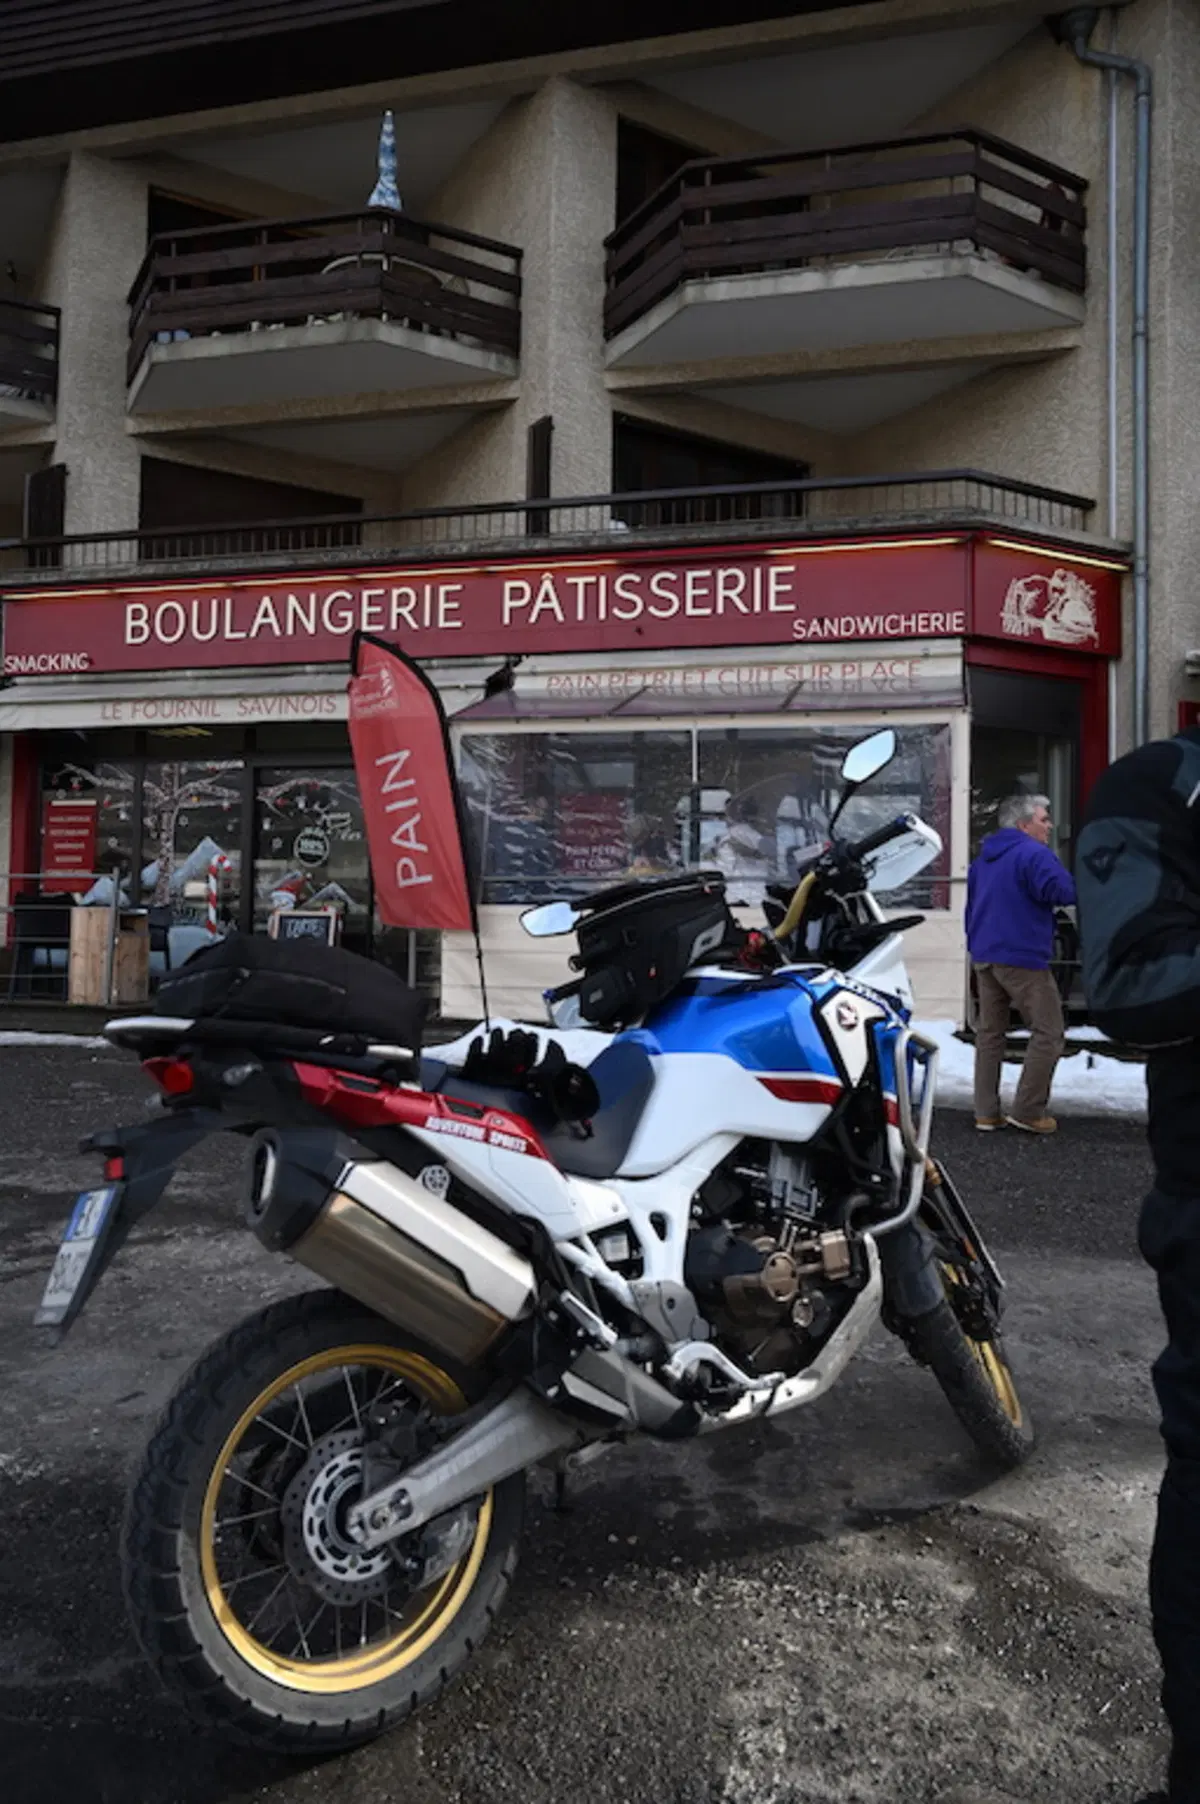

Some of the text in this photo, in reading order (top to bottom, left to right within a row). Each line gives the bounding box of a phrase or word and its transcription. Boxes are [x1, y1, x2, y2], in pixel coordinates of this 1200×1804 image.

[125, 565, 796, 645] BOULANGERIE PÂTISSERIE
[792, 611, 965, 639] SANDWICHERIE
[4, 652, 90, 673] SNACKING
[547, 673, 602, 691] PAIN
[682, 668, 712, 686] ET
[718, 666, 778, 684] CUIT
[784, 662, 833, 682] SUR
[840, 659, 922, 681] PLACE
[101, 702, 123, 721] LE
[131, 698, 221, 720] FOURNIL
[236, 694, 338, 717] SAVINOIS
[375, 749, 433, 888] PAIN
